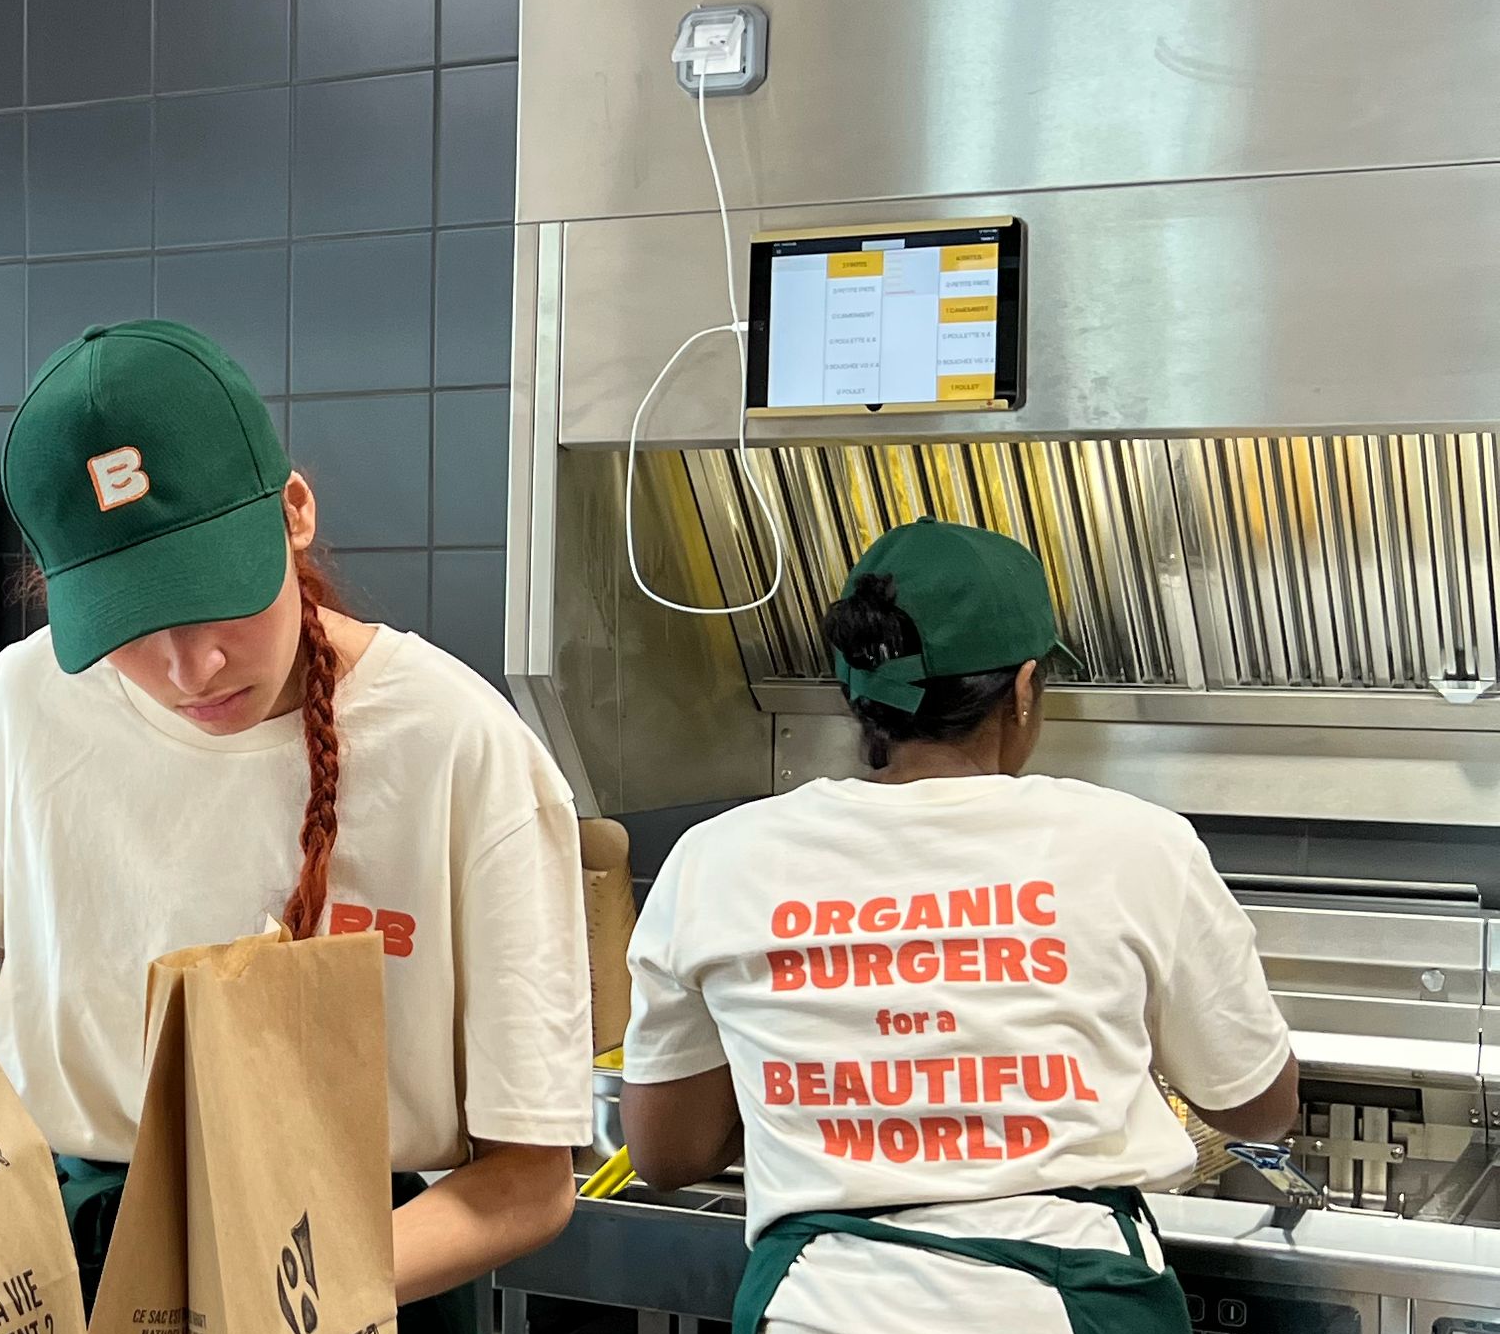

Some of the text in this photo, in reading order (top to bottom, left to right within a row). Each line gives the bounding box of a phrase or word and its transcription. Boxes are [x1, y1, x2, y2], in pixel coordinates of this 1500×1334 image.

[87, 446, 150, 511] B
[771, 880, 1056, 939] ORGANIC
[766, 938, 1068, 992] BURGERS
[876, 1009, 956, 1035] for a
[763, 1054, 1099, 1106] BEAUTIFUL
[816, 1115, 1049, 1164] WORLD
[3, 1269, 44, 1317] VIE
[132, 1309, 147, 1324] CE
[148, 1309, 169, 1325] SAC
